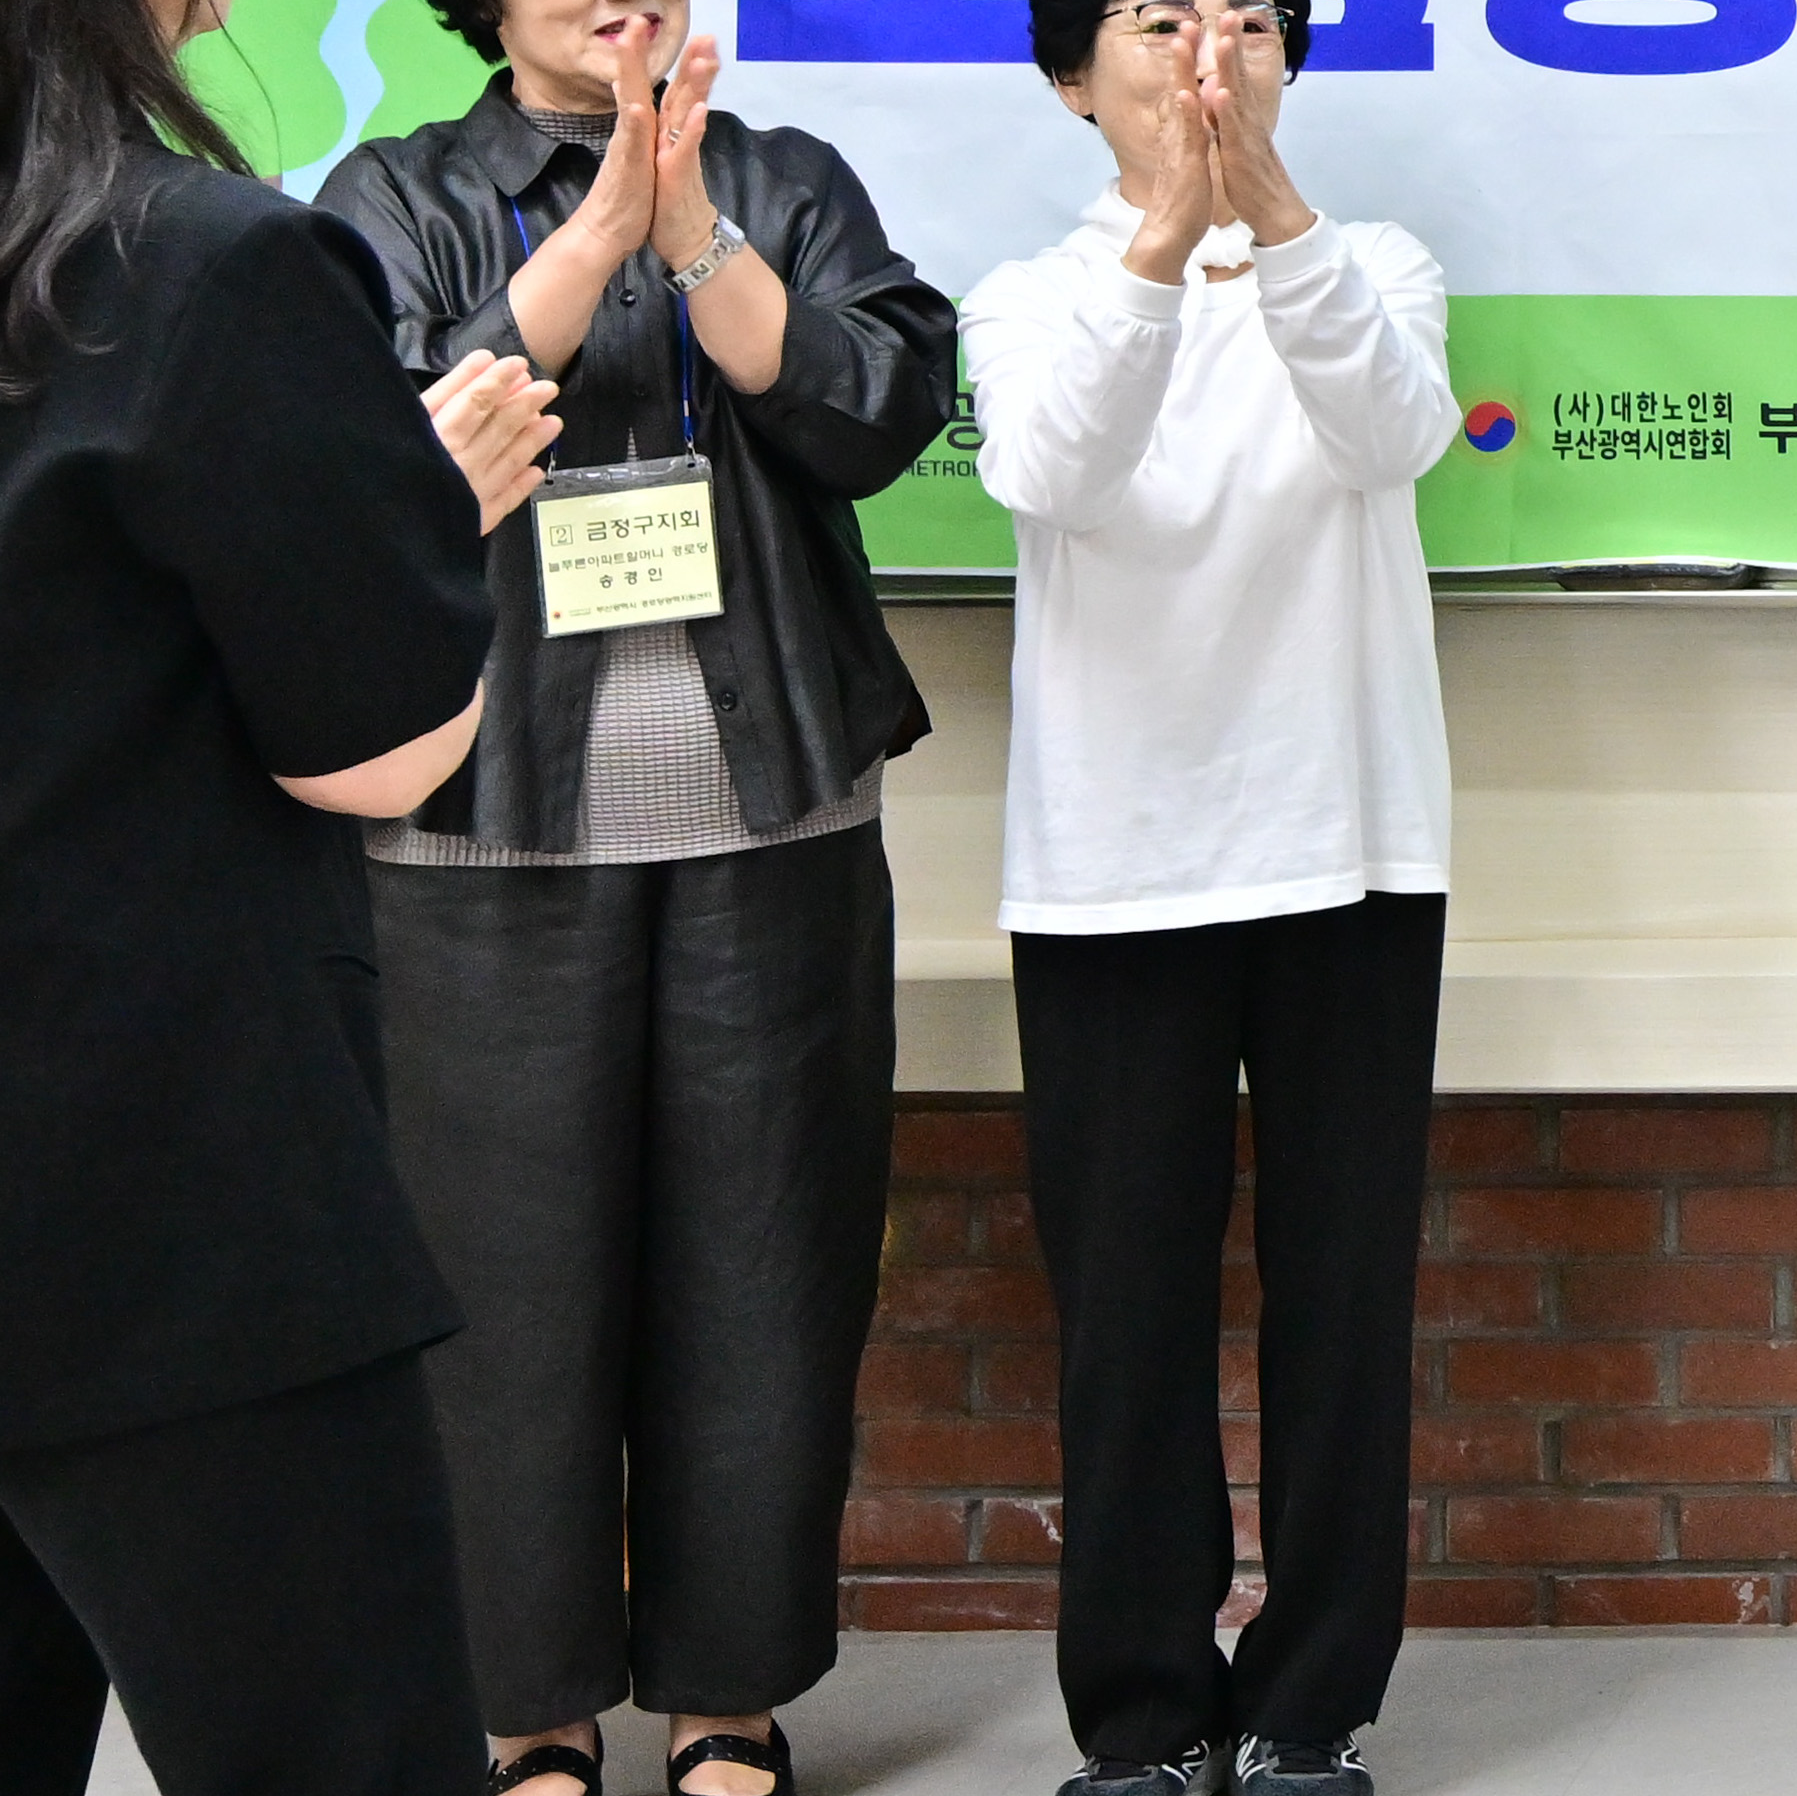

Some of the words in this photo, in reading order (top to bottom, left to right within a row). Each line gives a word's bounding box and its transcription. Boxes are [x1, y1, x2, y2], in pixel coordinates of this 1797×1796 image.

[1552, 391, 1734, 425] (사)대한노인회
[1551, 427, 1733, 461] 부산광역시연합회
[555, 527, 568, 545] 2
[586, 509, 701, 542] 금정구지회
[671, 541, 709, 558] 경로당
[647, 567, 664, 582] 인
